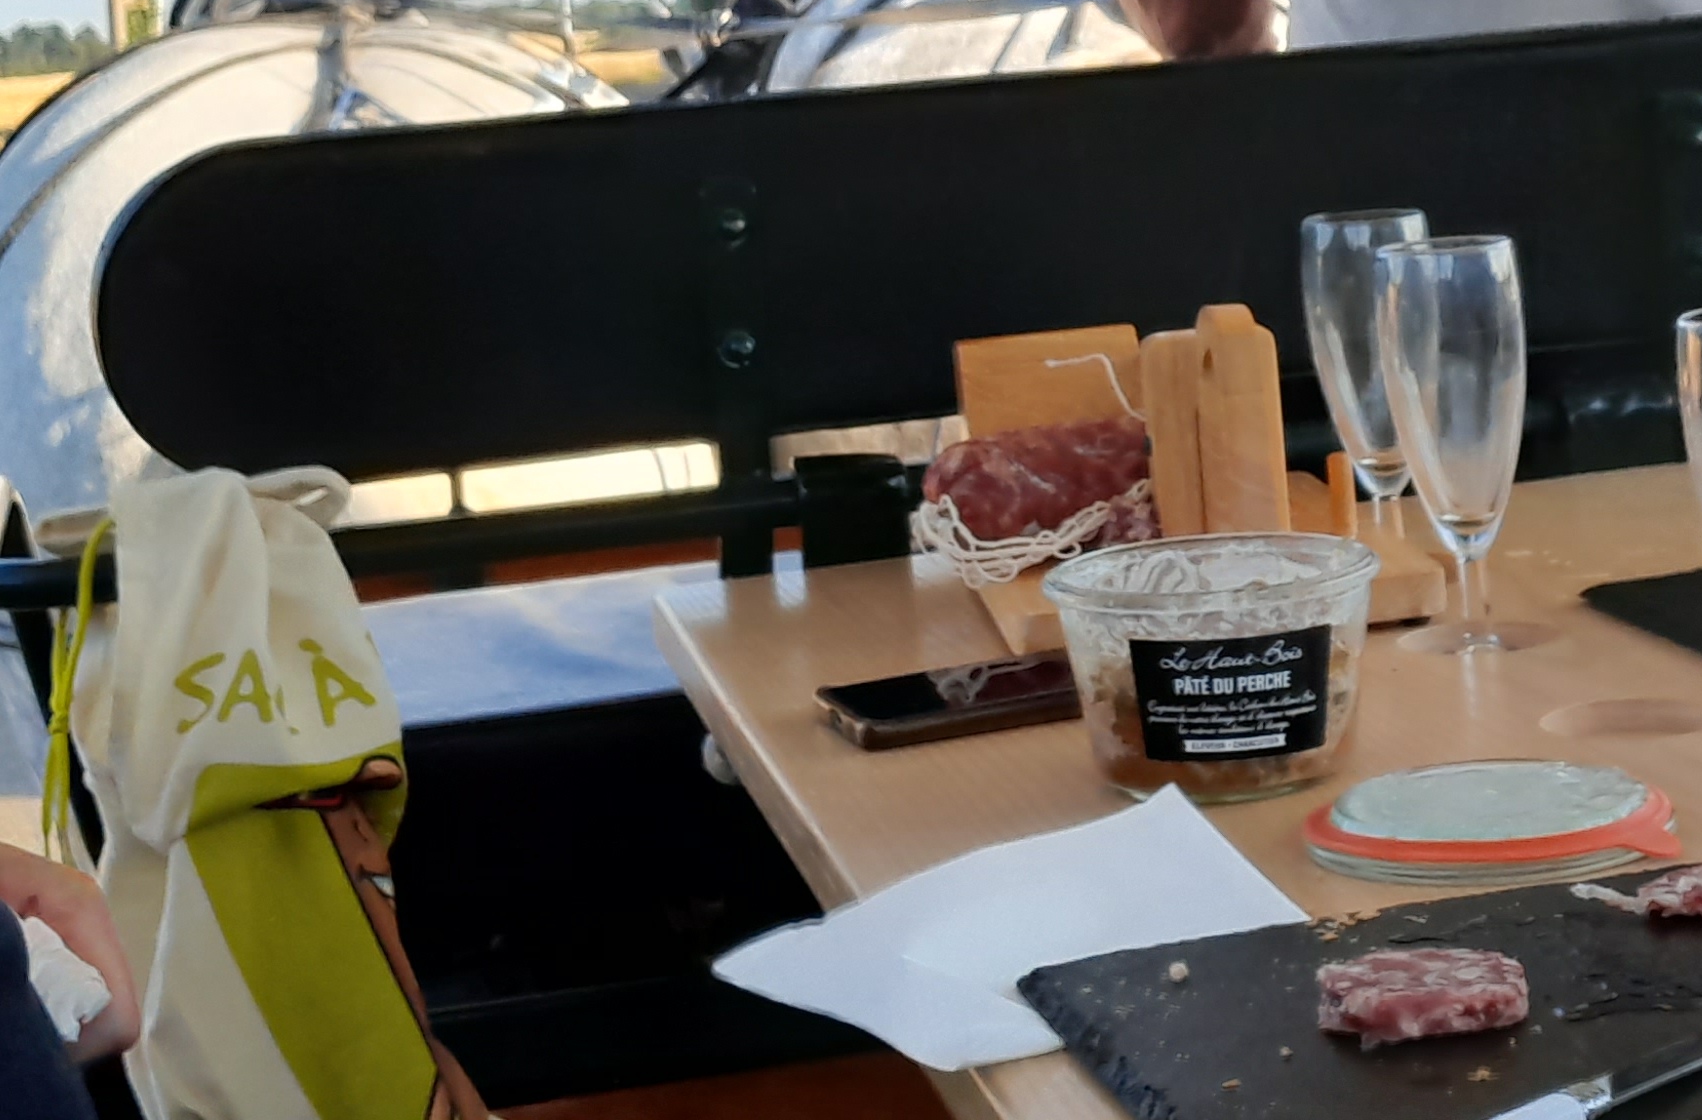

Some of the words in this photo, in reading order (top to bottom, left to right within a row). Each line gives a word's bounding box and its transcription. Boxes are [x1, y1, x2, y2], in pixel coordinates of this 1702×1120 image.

[1159, 646, 1190, 672] Le
[173, 648, 300, 735] SA
[1174, 674, 1211, 696] PÂTÉ
[1212, 677, 1235, 695] DU
[1237, 670, 1292, 694] PERCHE
